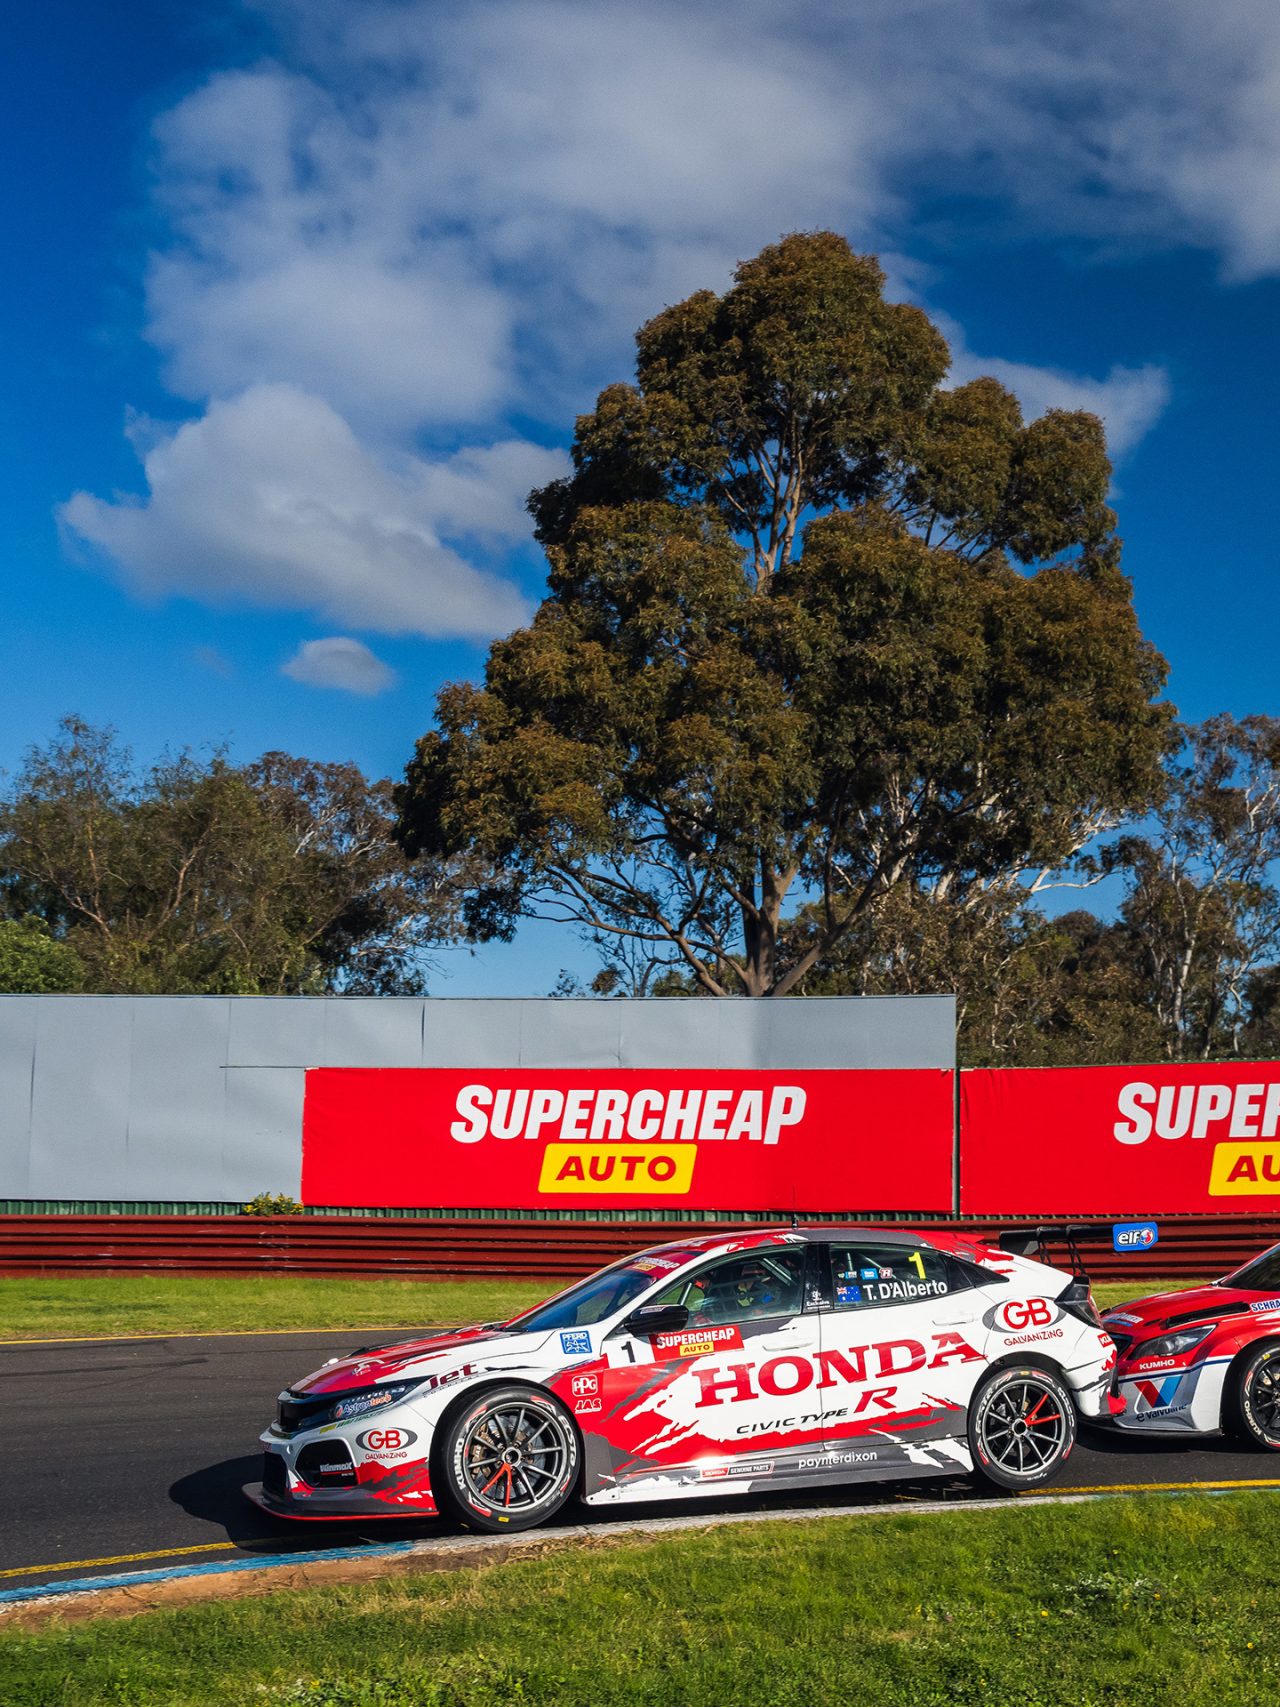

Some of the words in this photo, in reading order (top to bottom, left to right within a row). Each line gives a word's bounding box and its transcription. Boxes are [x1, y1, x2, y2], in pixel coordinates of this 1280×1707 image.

[450, 1085, 807, 1144] SUPERCHEAP
[555, 1156, 676, 1182] AUTO
[1118, 1230, 1140, 1244] elf
[907, 1251, 926, 1280] 1
[863, 1285, 877, 1301] T.
[879, 1280, 948, 1299] D'Alberto
[1003, 1299, 1052, 1330] GB
[562, 1332, 588, 1340] PFERD
[656, 1327, 735, 1350] SUPERCHEAP
[621, 1341, 636, 1363] 1
[683, 1344, 710, 1353] AUTO
[692, 1332, 989, 1408] HONDA
[1139, 1359, 1176, 1370] KUMHO
[573, 1377, 597, 1395] PPG
[736, 1417, 797, 1434] CIVIC
[800, 1408, 848, 1424] TYPE
[853, 1386, 898, 1414] R
[367, 1430, 401, 1450] GB
[454, 1437, 467, 1491] KUMHO
[798, 1450, 878, 1469] paynterdixon
